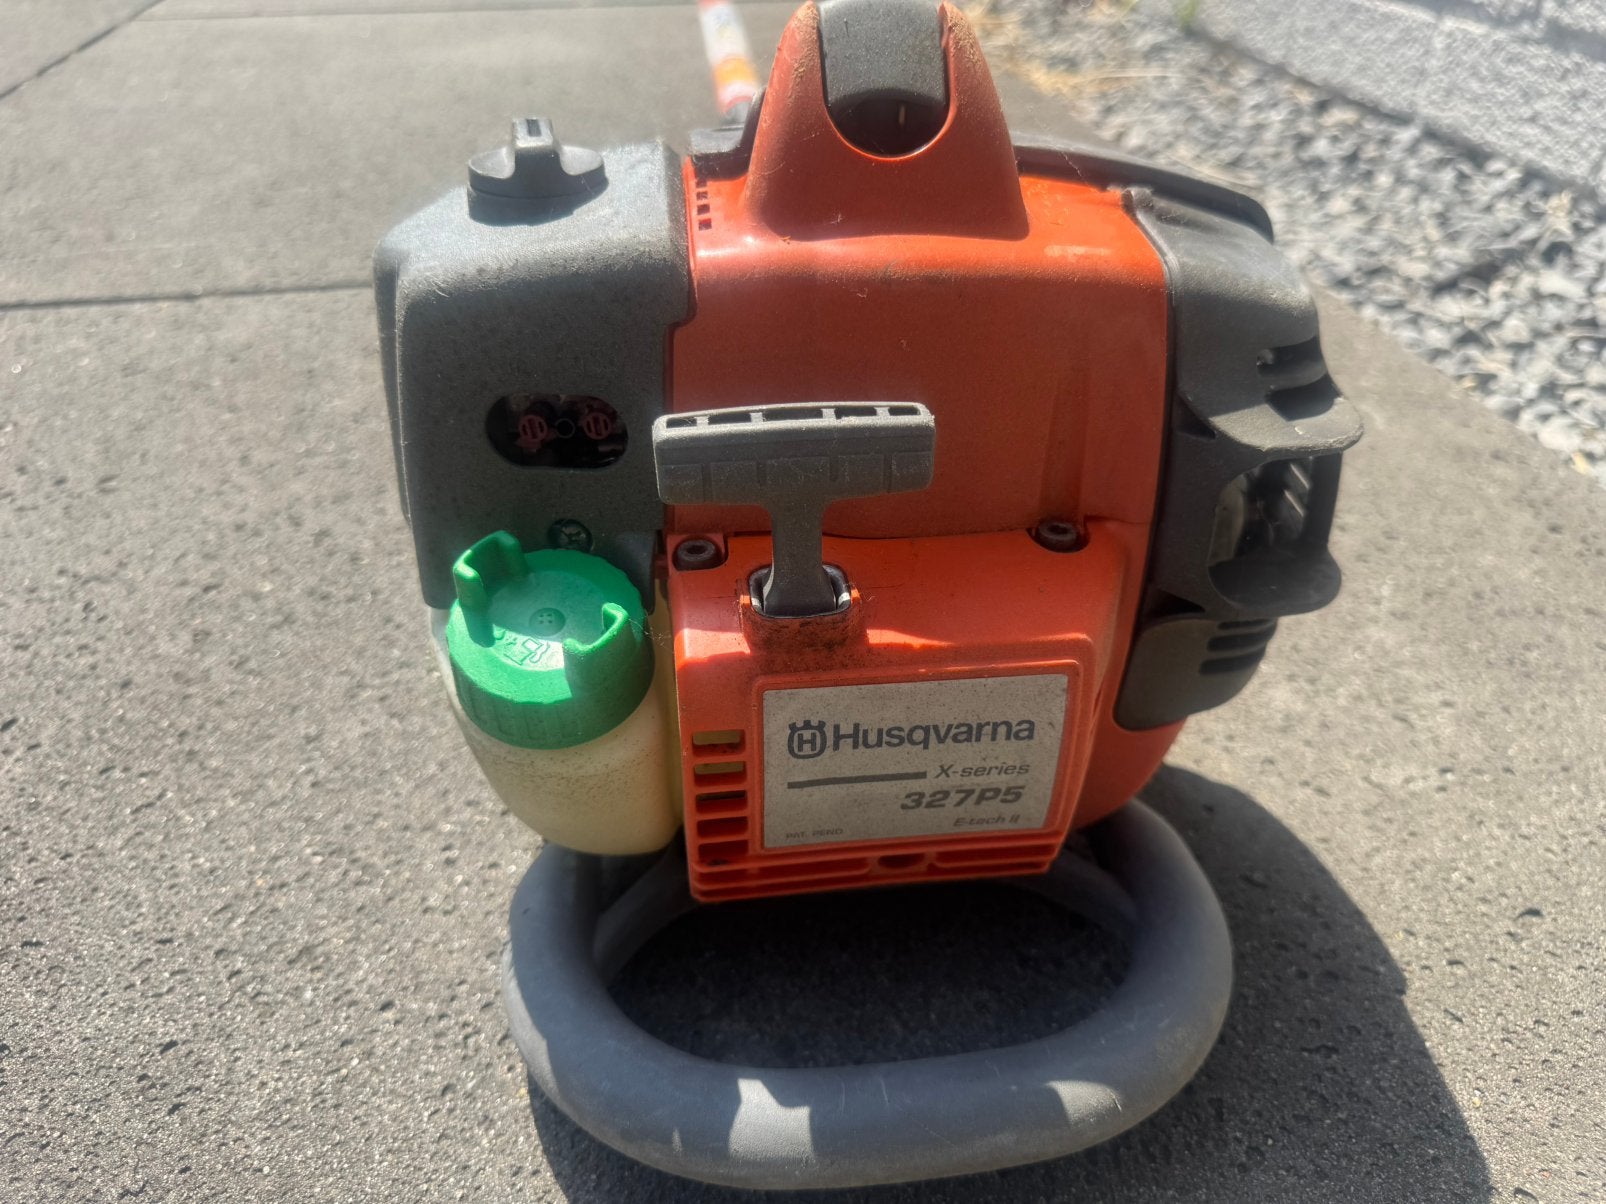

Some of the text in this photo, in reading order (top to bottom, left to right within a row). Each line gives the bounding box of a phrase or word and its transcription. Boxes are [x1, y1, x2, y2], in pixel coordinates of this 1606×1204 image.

[832, 719, 1036, 751] Husqvarna
[934, 762, 1031, 779] X-series
[900, 785, 1026, 810] 327P5
